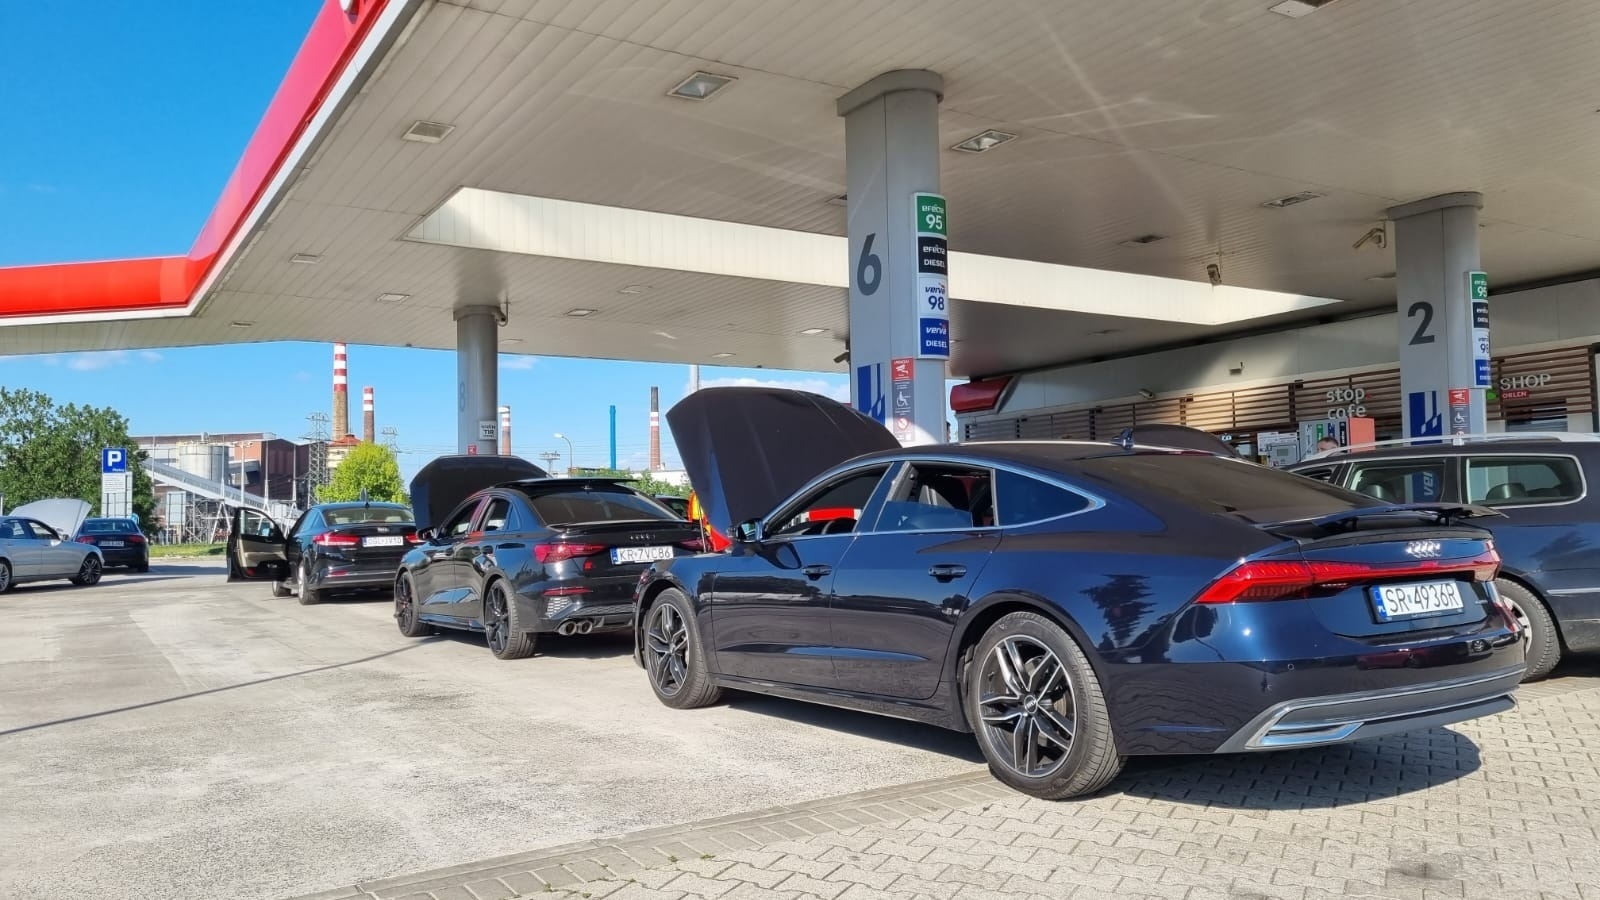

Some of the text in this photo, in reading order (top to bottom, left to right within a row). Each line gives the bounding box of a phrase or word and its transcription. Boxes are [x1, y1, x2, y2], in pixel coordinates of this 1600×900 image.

[926, 214, 943, 230] 95
[857, 232, 882, 296] 6
[924, 259, 945, 268] DIESEL
[928, 295, 945, 311] 98
[1407, 302, 1435, 345] 2
[926, 340, 947, 348] DIESEL
[1500, 373, 1551, 390] SHOP
[1326, 388, 1365, 404] stop
[107, 450, 122, 467] P
